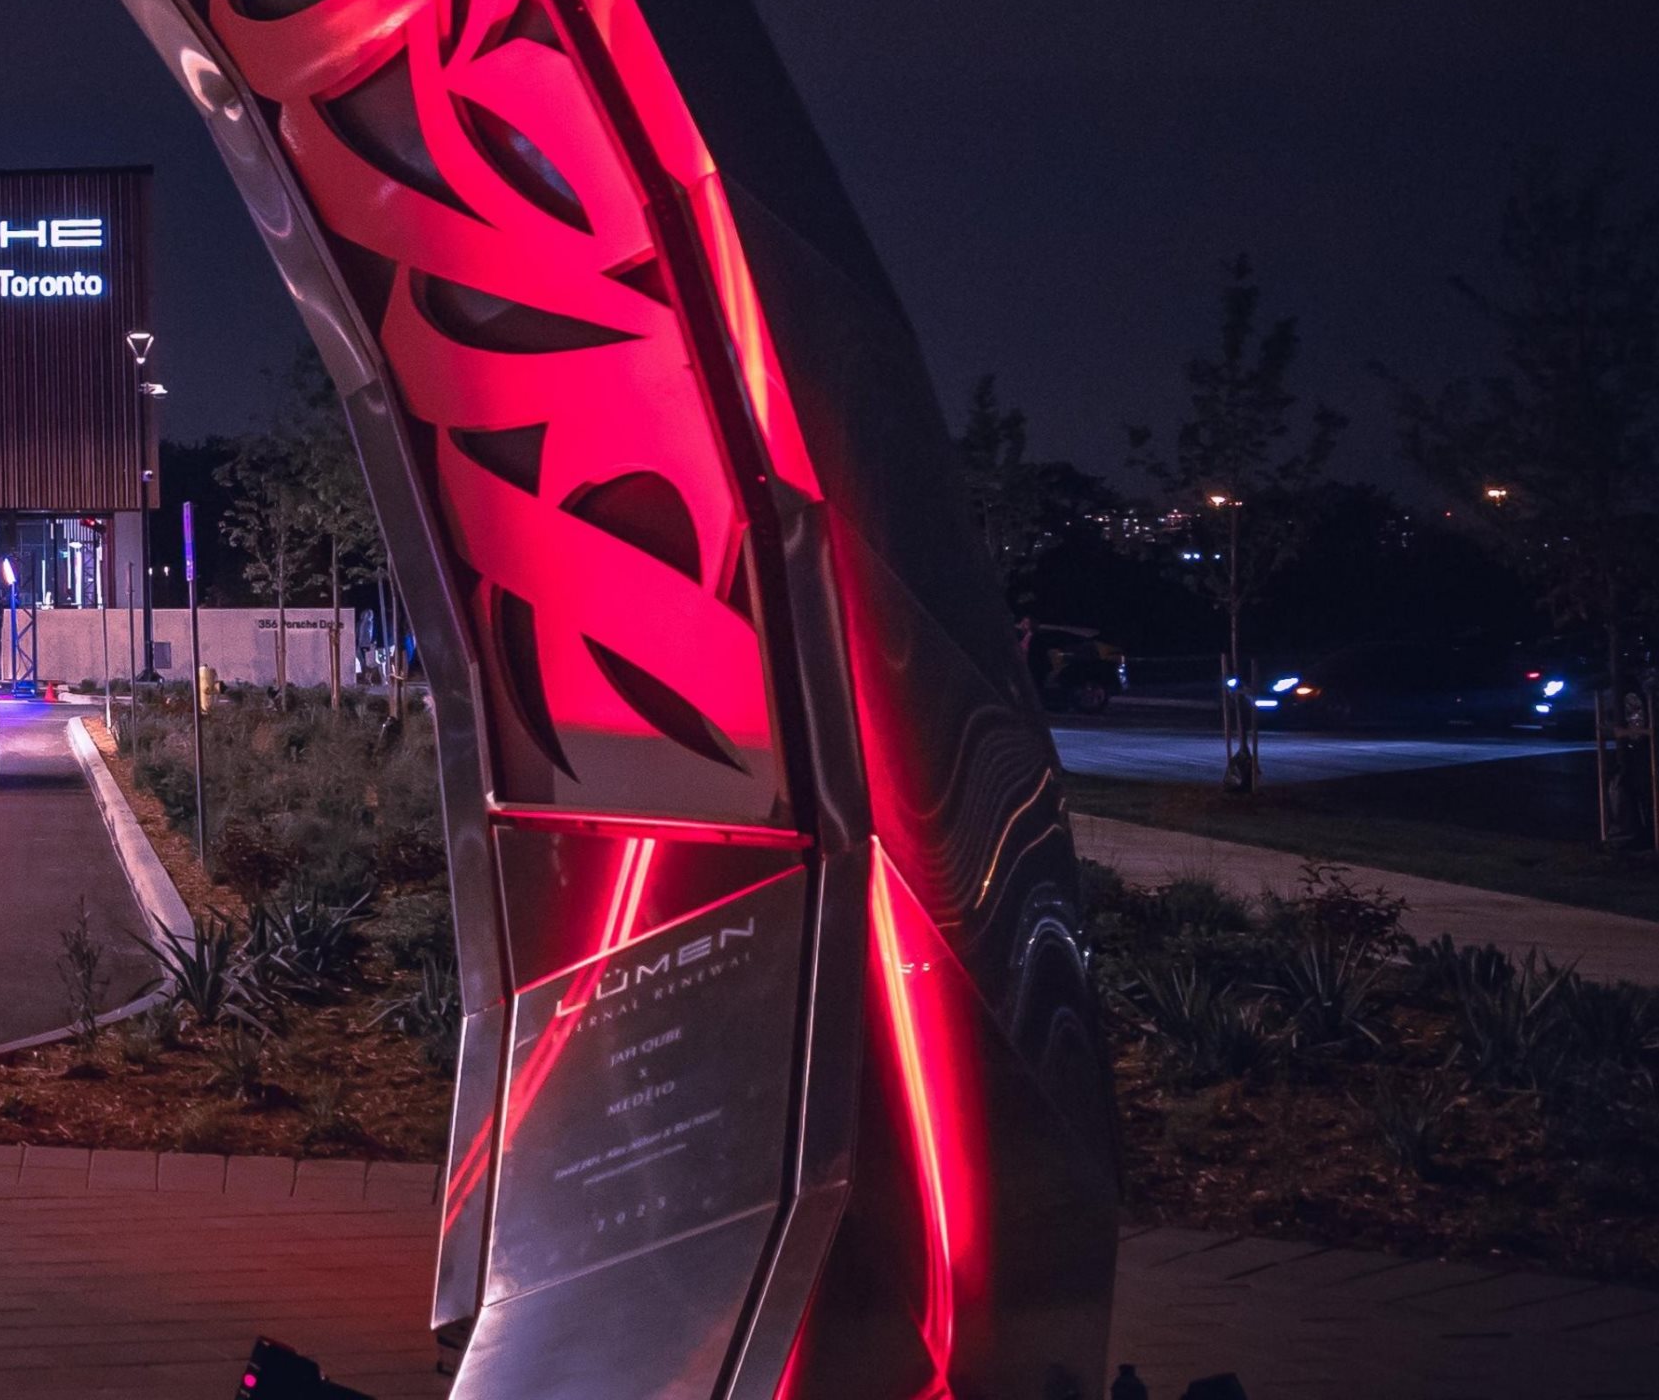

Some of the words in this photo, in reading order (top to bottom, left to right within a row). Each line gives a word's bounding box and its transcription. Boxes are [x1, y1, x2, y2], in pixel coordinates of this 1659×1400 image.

[258, 620, 278, 629] 356
[282, 620, 317, 629] orsche
[555, 916, 755, 1018] LÜMEN
